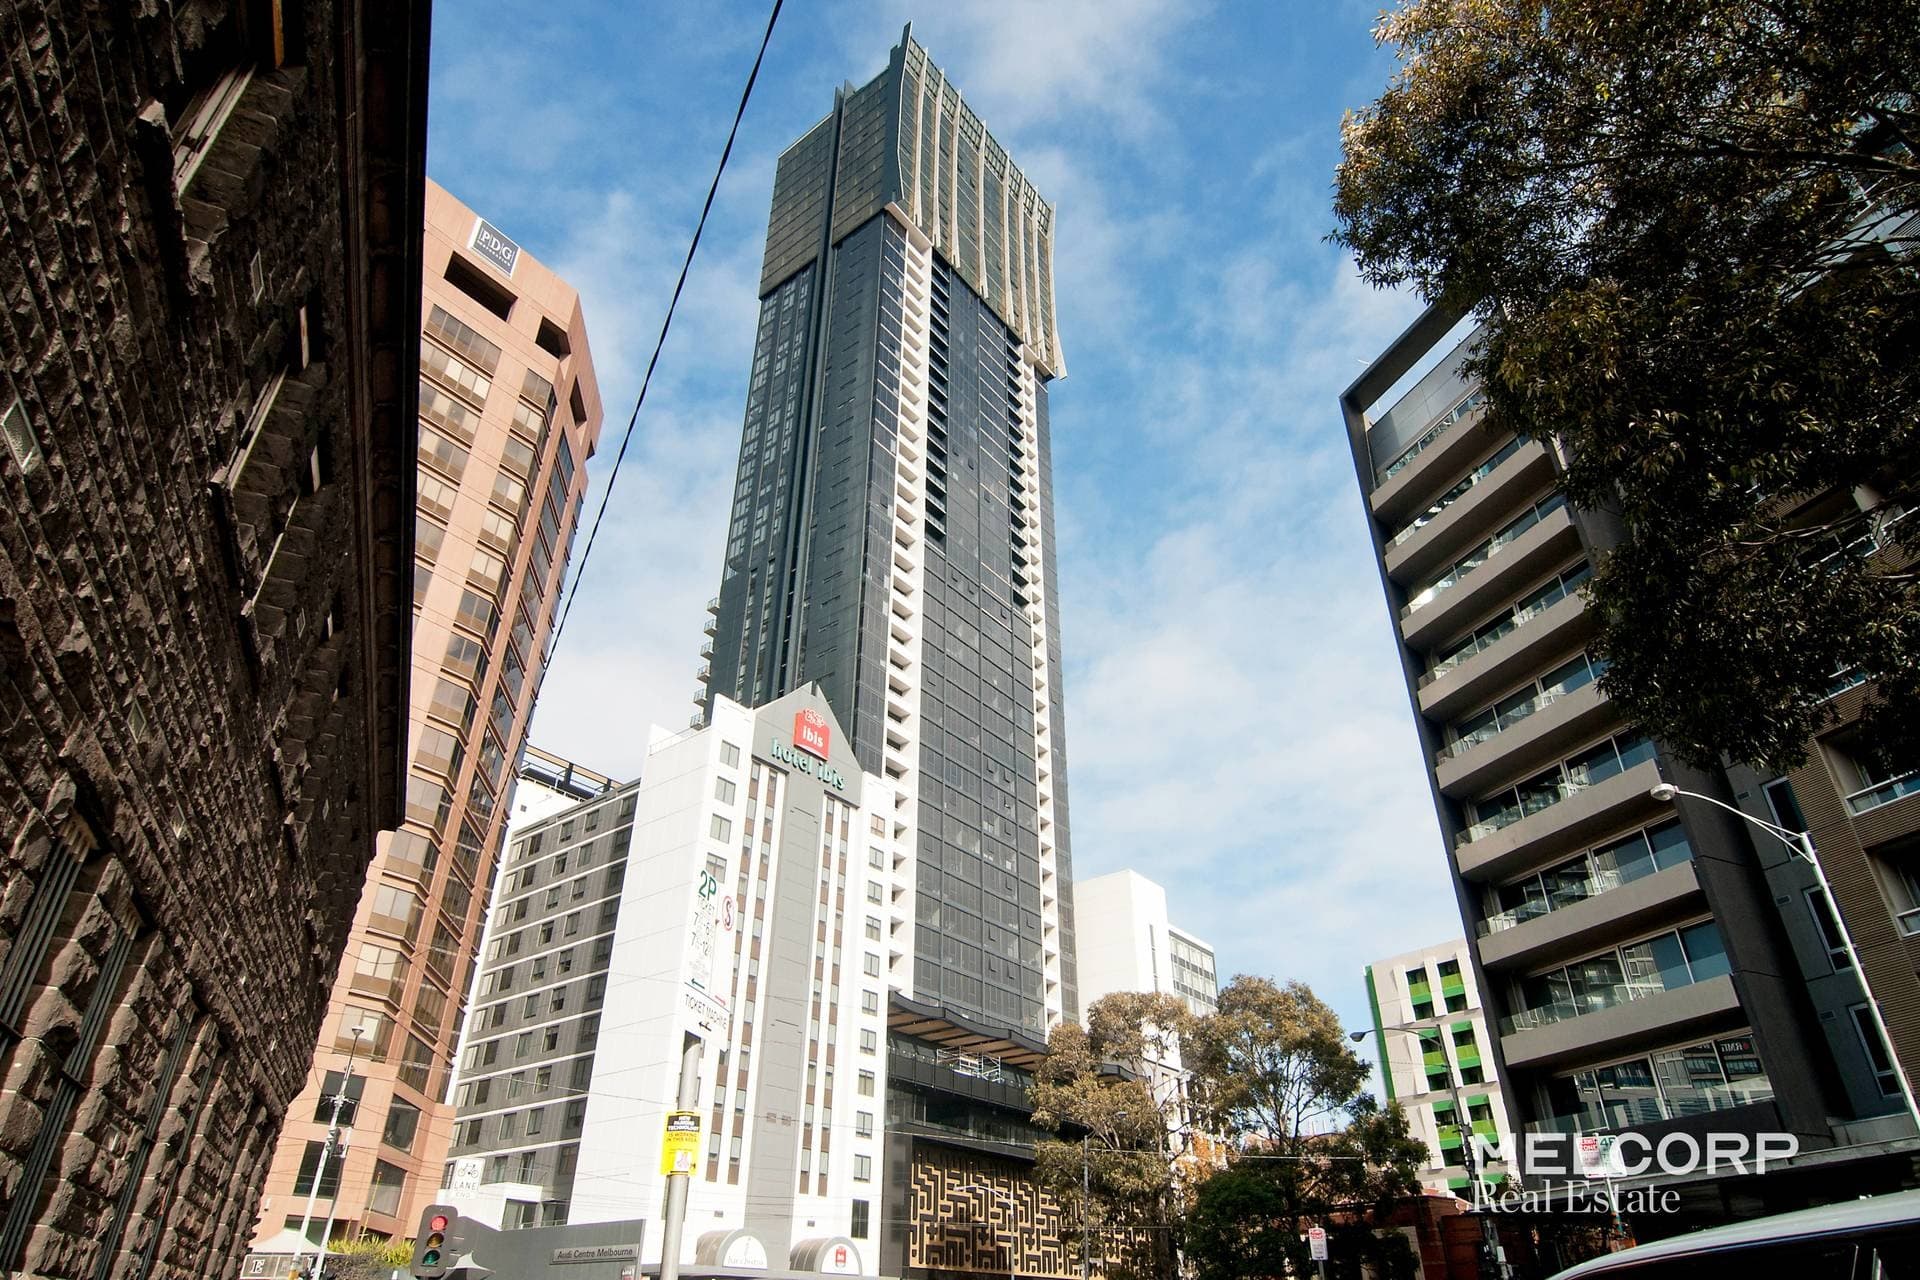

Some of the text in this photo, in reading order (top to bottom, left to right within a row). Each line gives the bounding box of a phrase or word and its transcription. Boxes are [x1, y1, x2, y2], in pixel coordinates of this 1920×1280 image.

[479, 229, 513, 260] PDG
[802, 725, 824, 748] ibis
[771, 737, 845, 791] hotel ibis
[698, 869, 717, 901] 2P
[685, 993, 706, 1015] TICKET
[454, 1180, 477, 1191] LANE
[557, 1247, 633, 1260] Audi Centre Melbourne
